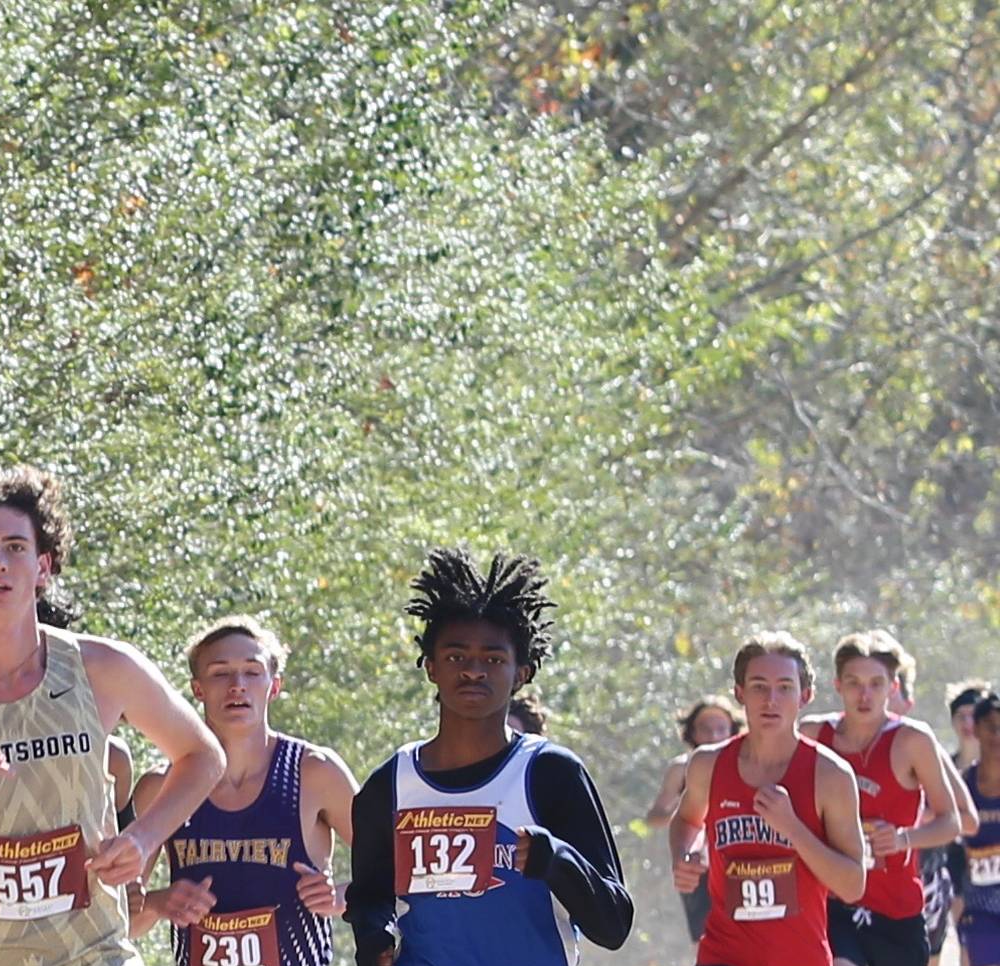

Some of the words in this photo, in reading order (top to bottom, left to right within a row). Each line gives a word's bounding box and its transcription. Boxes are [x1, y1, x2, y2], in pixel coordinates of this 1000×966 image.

[715, 814, 793, 851] BREW
[173, 838, 292, 869] FAIRVIEW
[411, 833, 476, 876] 132
[742, 878, 775, 909] 99
